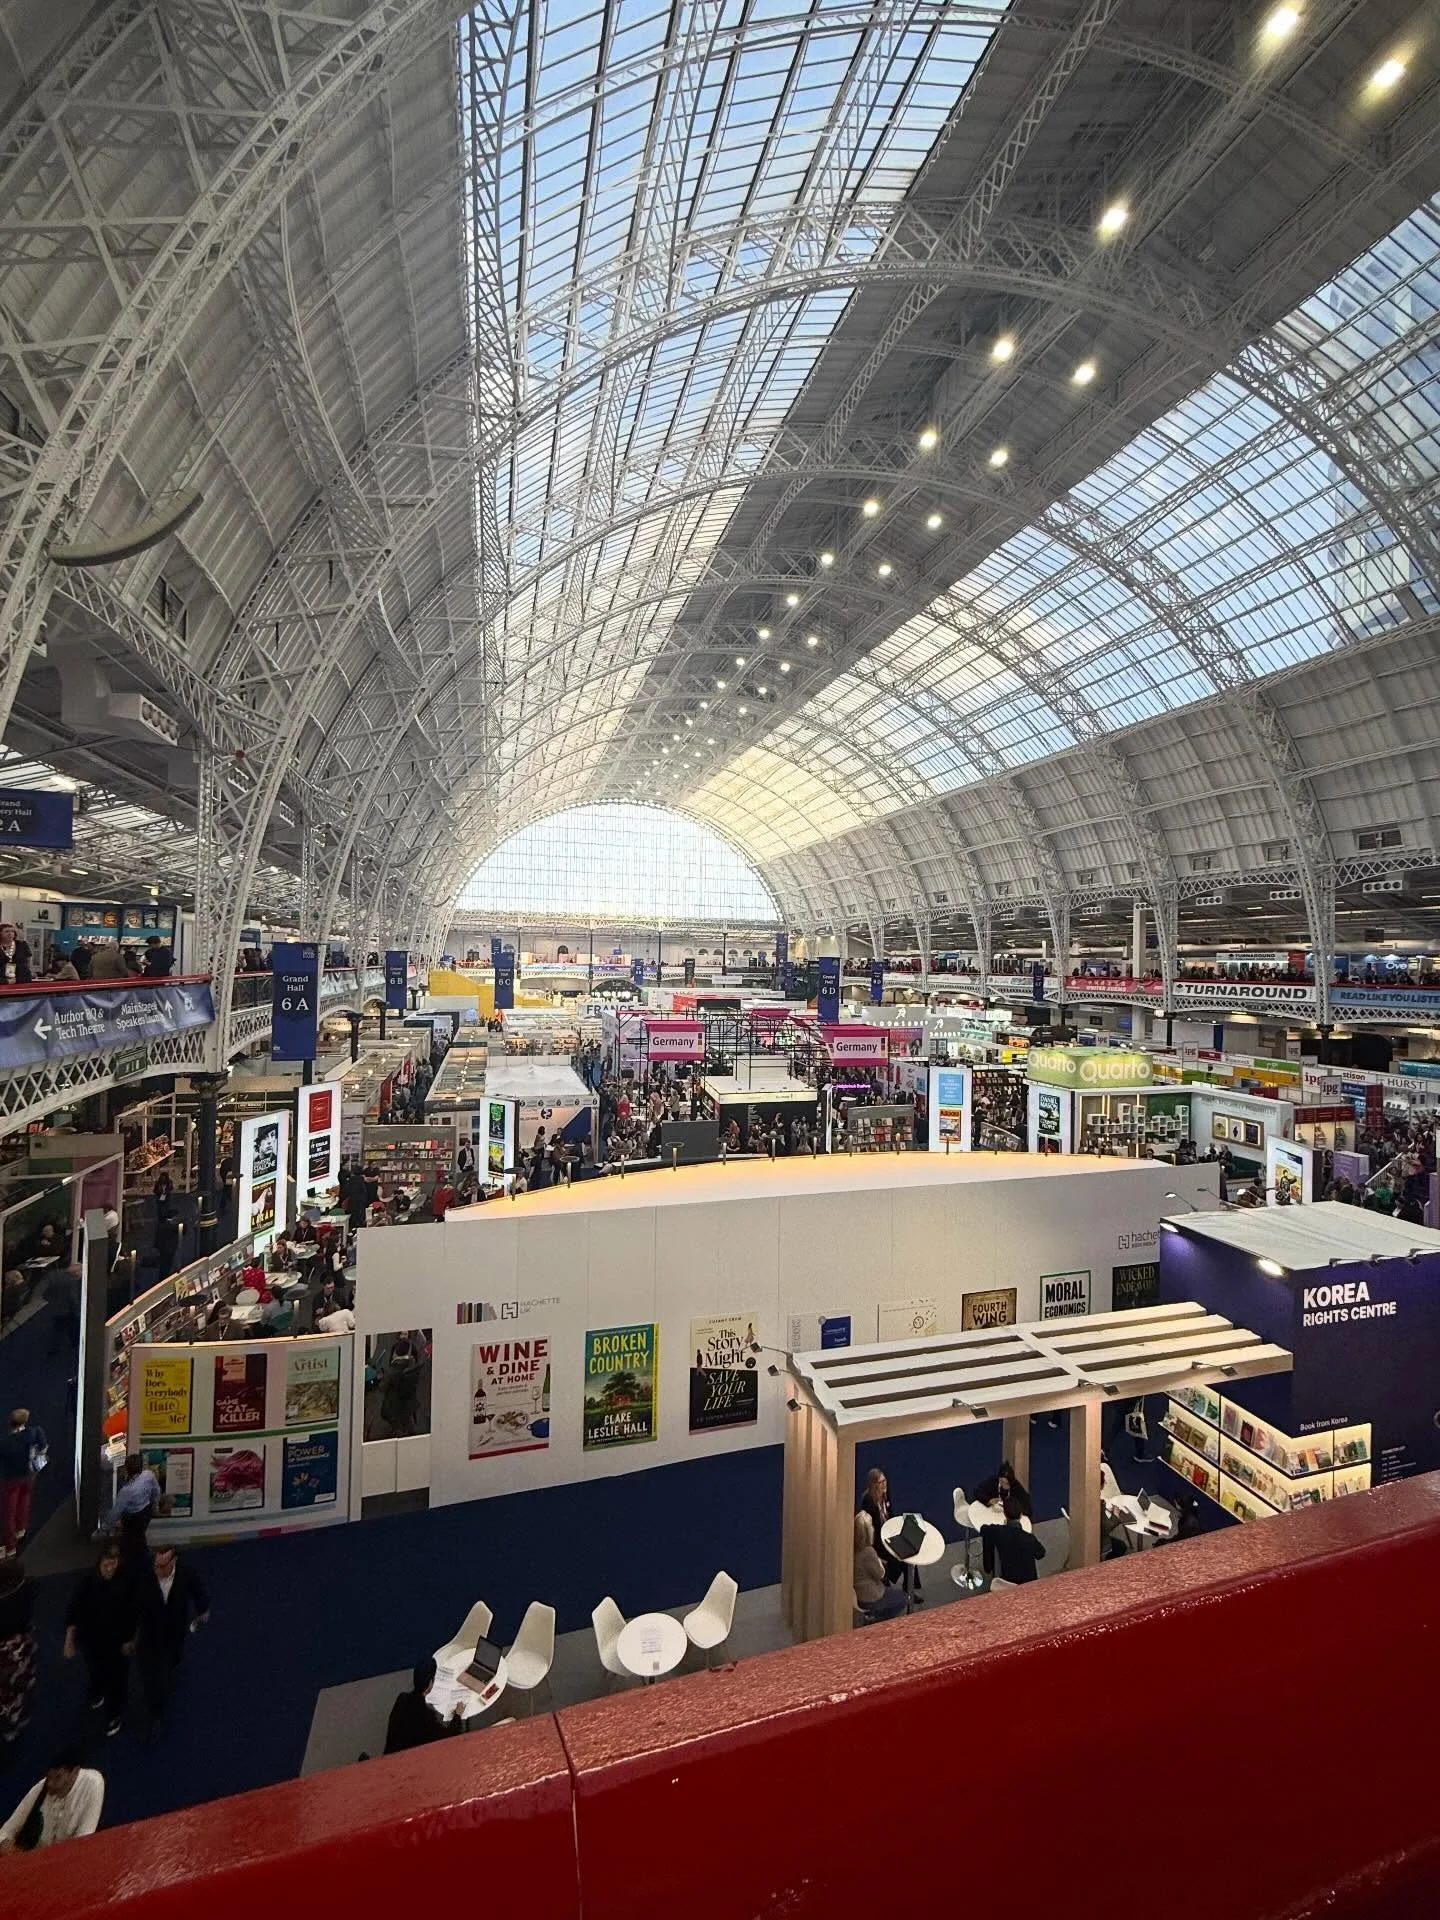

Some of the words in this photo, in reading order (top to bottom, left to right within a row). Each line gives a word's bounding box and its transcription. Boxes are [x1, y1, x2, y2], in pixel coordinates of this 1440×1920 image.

[1185, 985, 1307, 999] TURNAROUND
[1389, 994, 1410, 1002] YOU
[282, 998, 292, 1010] 6
[296, 998, 309, 1010] A
[55, 1010, 84, 1024] Author
[56, 1026, 77, 1040] Tech
[652, 1036, 694, 1049] Germany
[836, 1042, 877, 1053] Germany
[1028, 1051, 1076, 1073] Quarto
[1080, 1060, 1150, 1084] Quarto
[1323, 1082, 1338, 1095] ipg
[1387, 1078, 1425, 1090] HURST
[1120, 1266, 1154, 1280] WICKED
[1046, 1280, 1085, 1304] MORAL
[1304, 1282, 1370, 1309] KOREA
[972, 1301, 1006, 1313] FOURTH
[1045, 1302, 1086, 1318] ECONOMICS
[1303, 1308, 1348, 1327] RIGHTS
[1351, 1301, 1397, 1320] CENTRE
[973, 1311, 1006, 1325] WING
[719, 1329, 736, 1339] This
[594, 1332, 646, 1355] BROKEN
[707, 1336, 744, 1352] Story
[480, 1339, 548, 1364] WINE
[590, 1350, 650, 1374] COUNTRY
[704, 1349, 745, 1369] Might
[146, 1369, 164, 1378] Why
[486, 1367, 494, 1375] &
[499, 1360, 540, 1376] DINE
[491, 1377, 504, 1385] AT
[507, 1373, 535, 1384] HOME
[707, 1369, 740, 1385] SAVE
[145, 1388, 187, 1398] Everybody
[711, 1380, 746, 1398] YOUR
[150, 1400, 175, 1412] Hate
[226, 1404, 248, 1413] CAT
[703, 1394, 734, 1411] LIFE
[220, 1412, 260, 1424] KILLER
[604, 1412, 632, 1425] CLARE
[1300, 1422, 1315, 1431] Book
[1316, 1420, 1330, 1428] from
[1331, 1416, 1348, 1425] Korea
[588, 1425, 619, 1439] LESLIE
[624, 1421, 647, 1435] HALL
